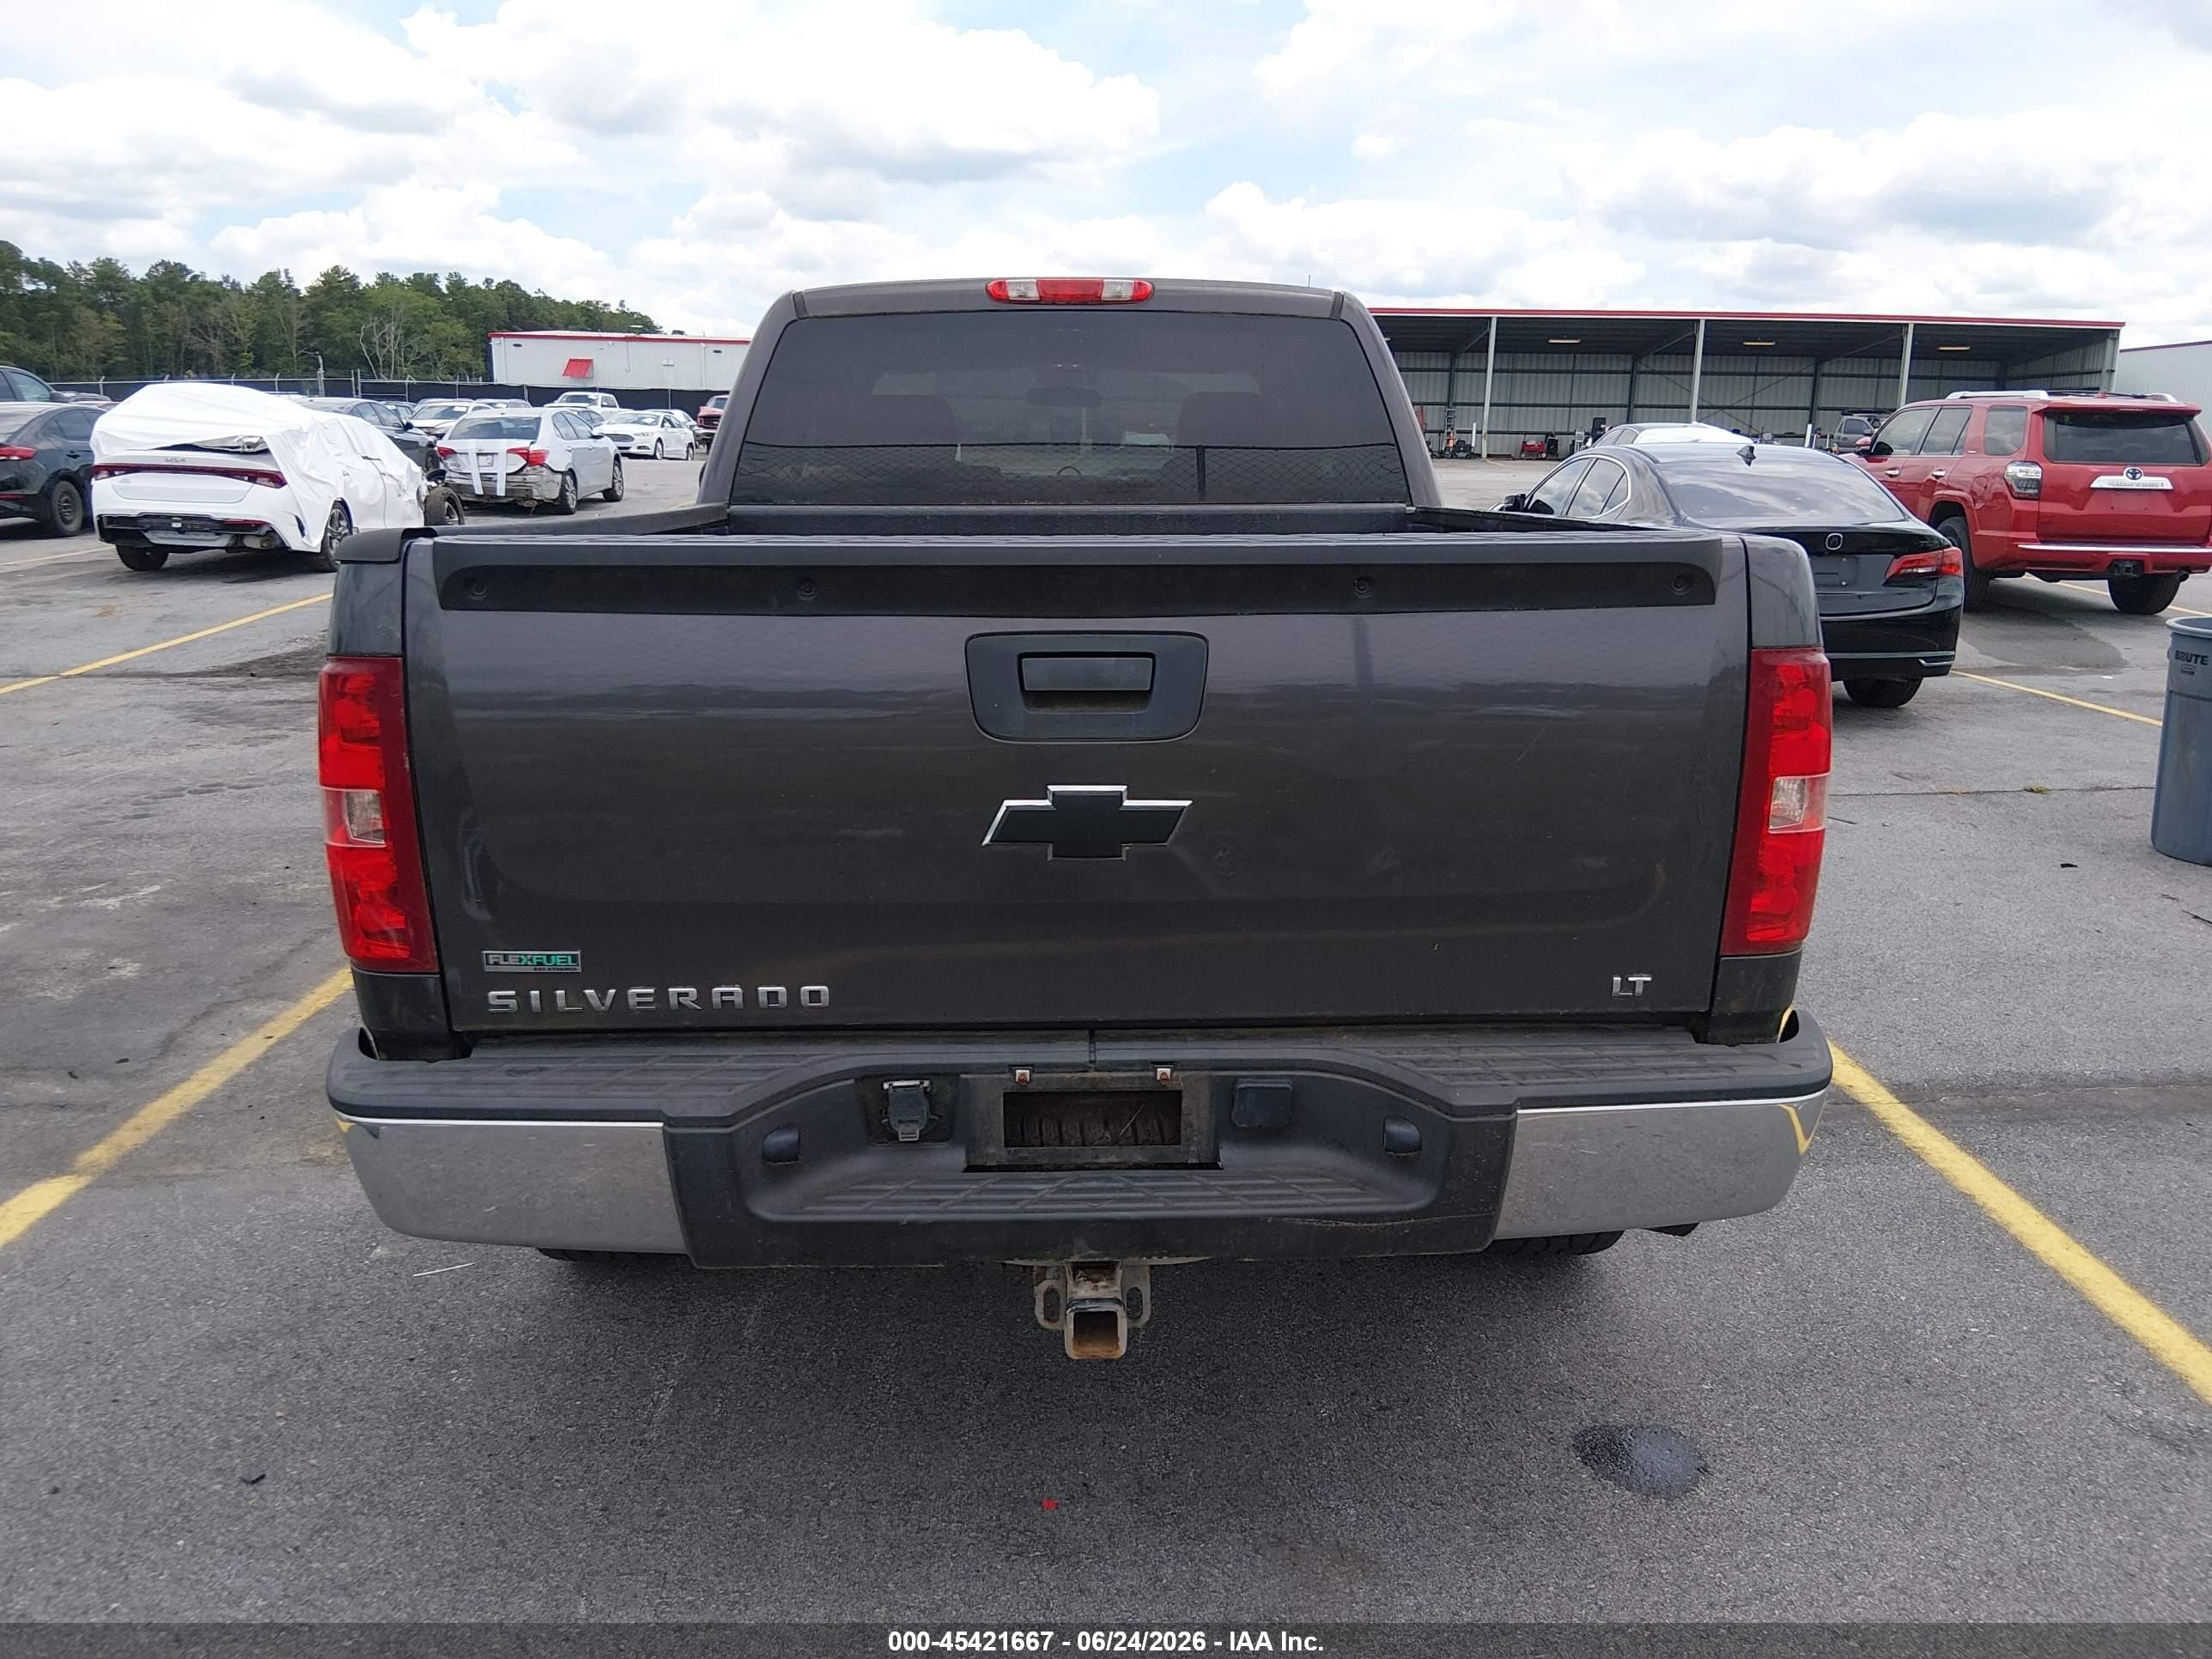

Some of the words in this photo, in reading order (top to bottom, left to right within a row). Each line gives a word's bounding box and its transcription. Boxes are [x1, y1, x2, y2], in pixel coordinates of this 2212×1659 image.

[2174, 649, 2209, 666] BRUTE
[487, 953, 579, 966] FLEXFUEL
[1611, 975, 1653, 997] LT
[487, 985, 830, 1013] SILVERADO
